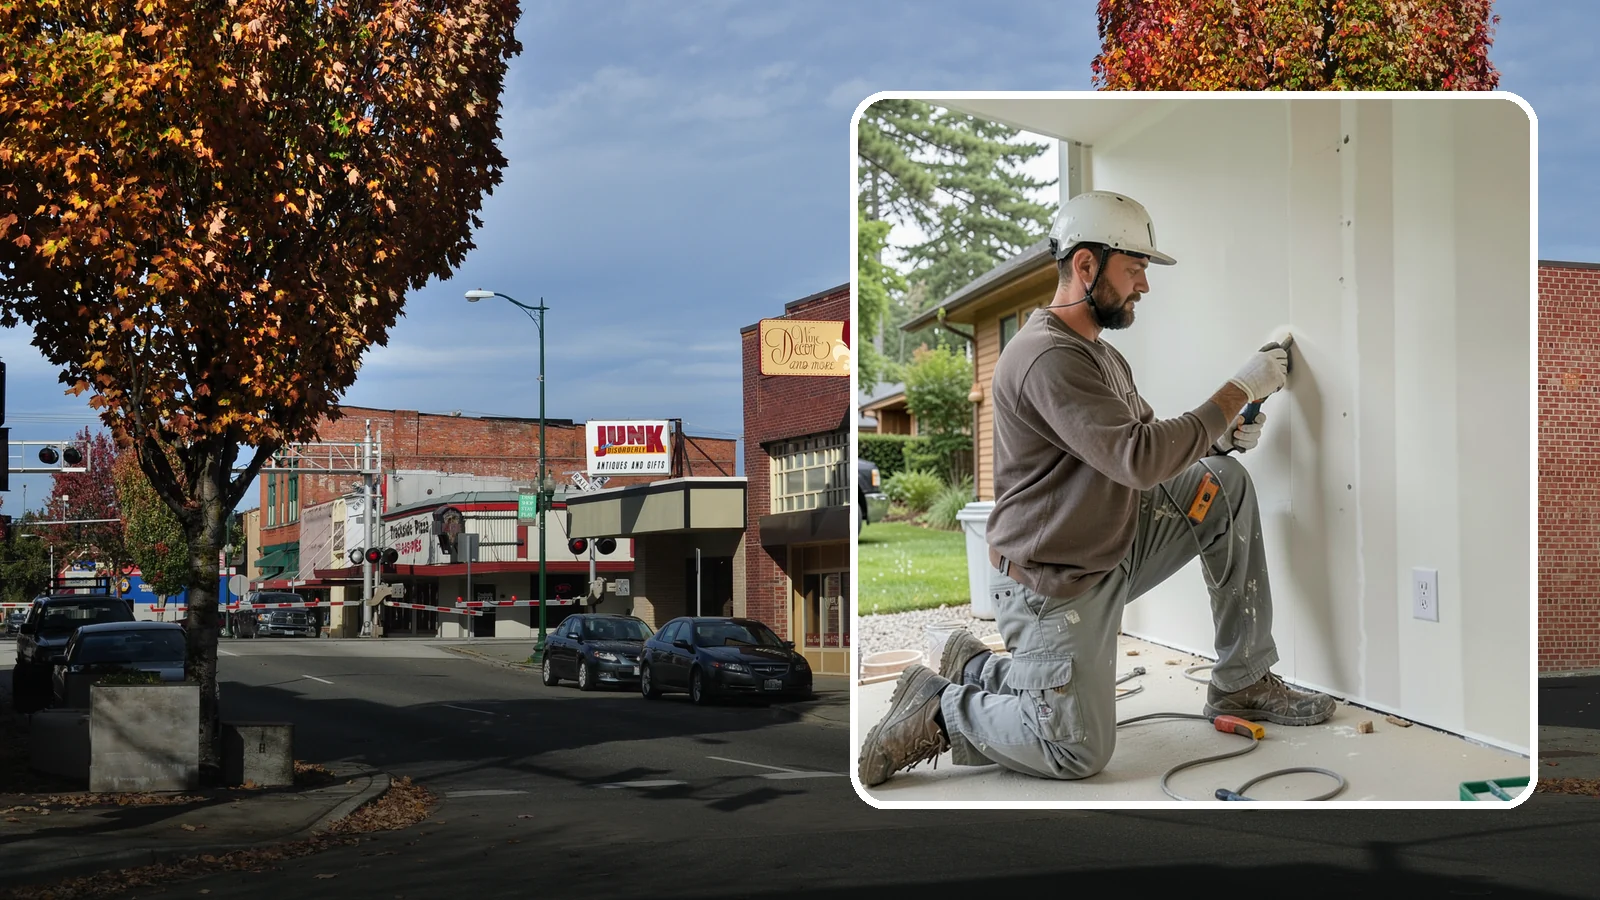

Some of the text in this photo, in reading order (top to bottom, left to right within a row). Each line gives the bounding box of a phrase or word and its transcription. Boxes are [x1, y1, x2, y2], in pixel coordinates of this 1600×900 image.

[595, 425, 665, 457] JUNK
[607, 446, 646, 454] DISORDERLY
[597, 461, 665, 470] ANTIQUES AND GIFTS
[352, 498, 365, 511] CRO
[390, 519, 429, 540] Trackside Pizza
